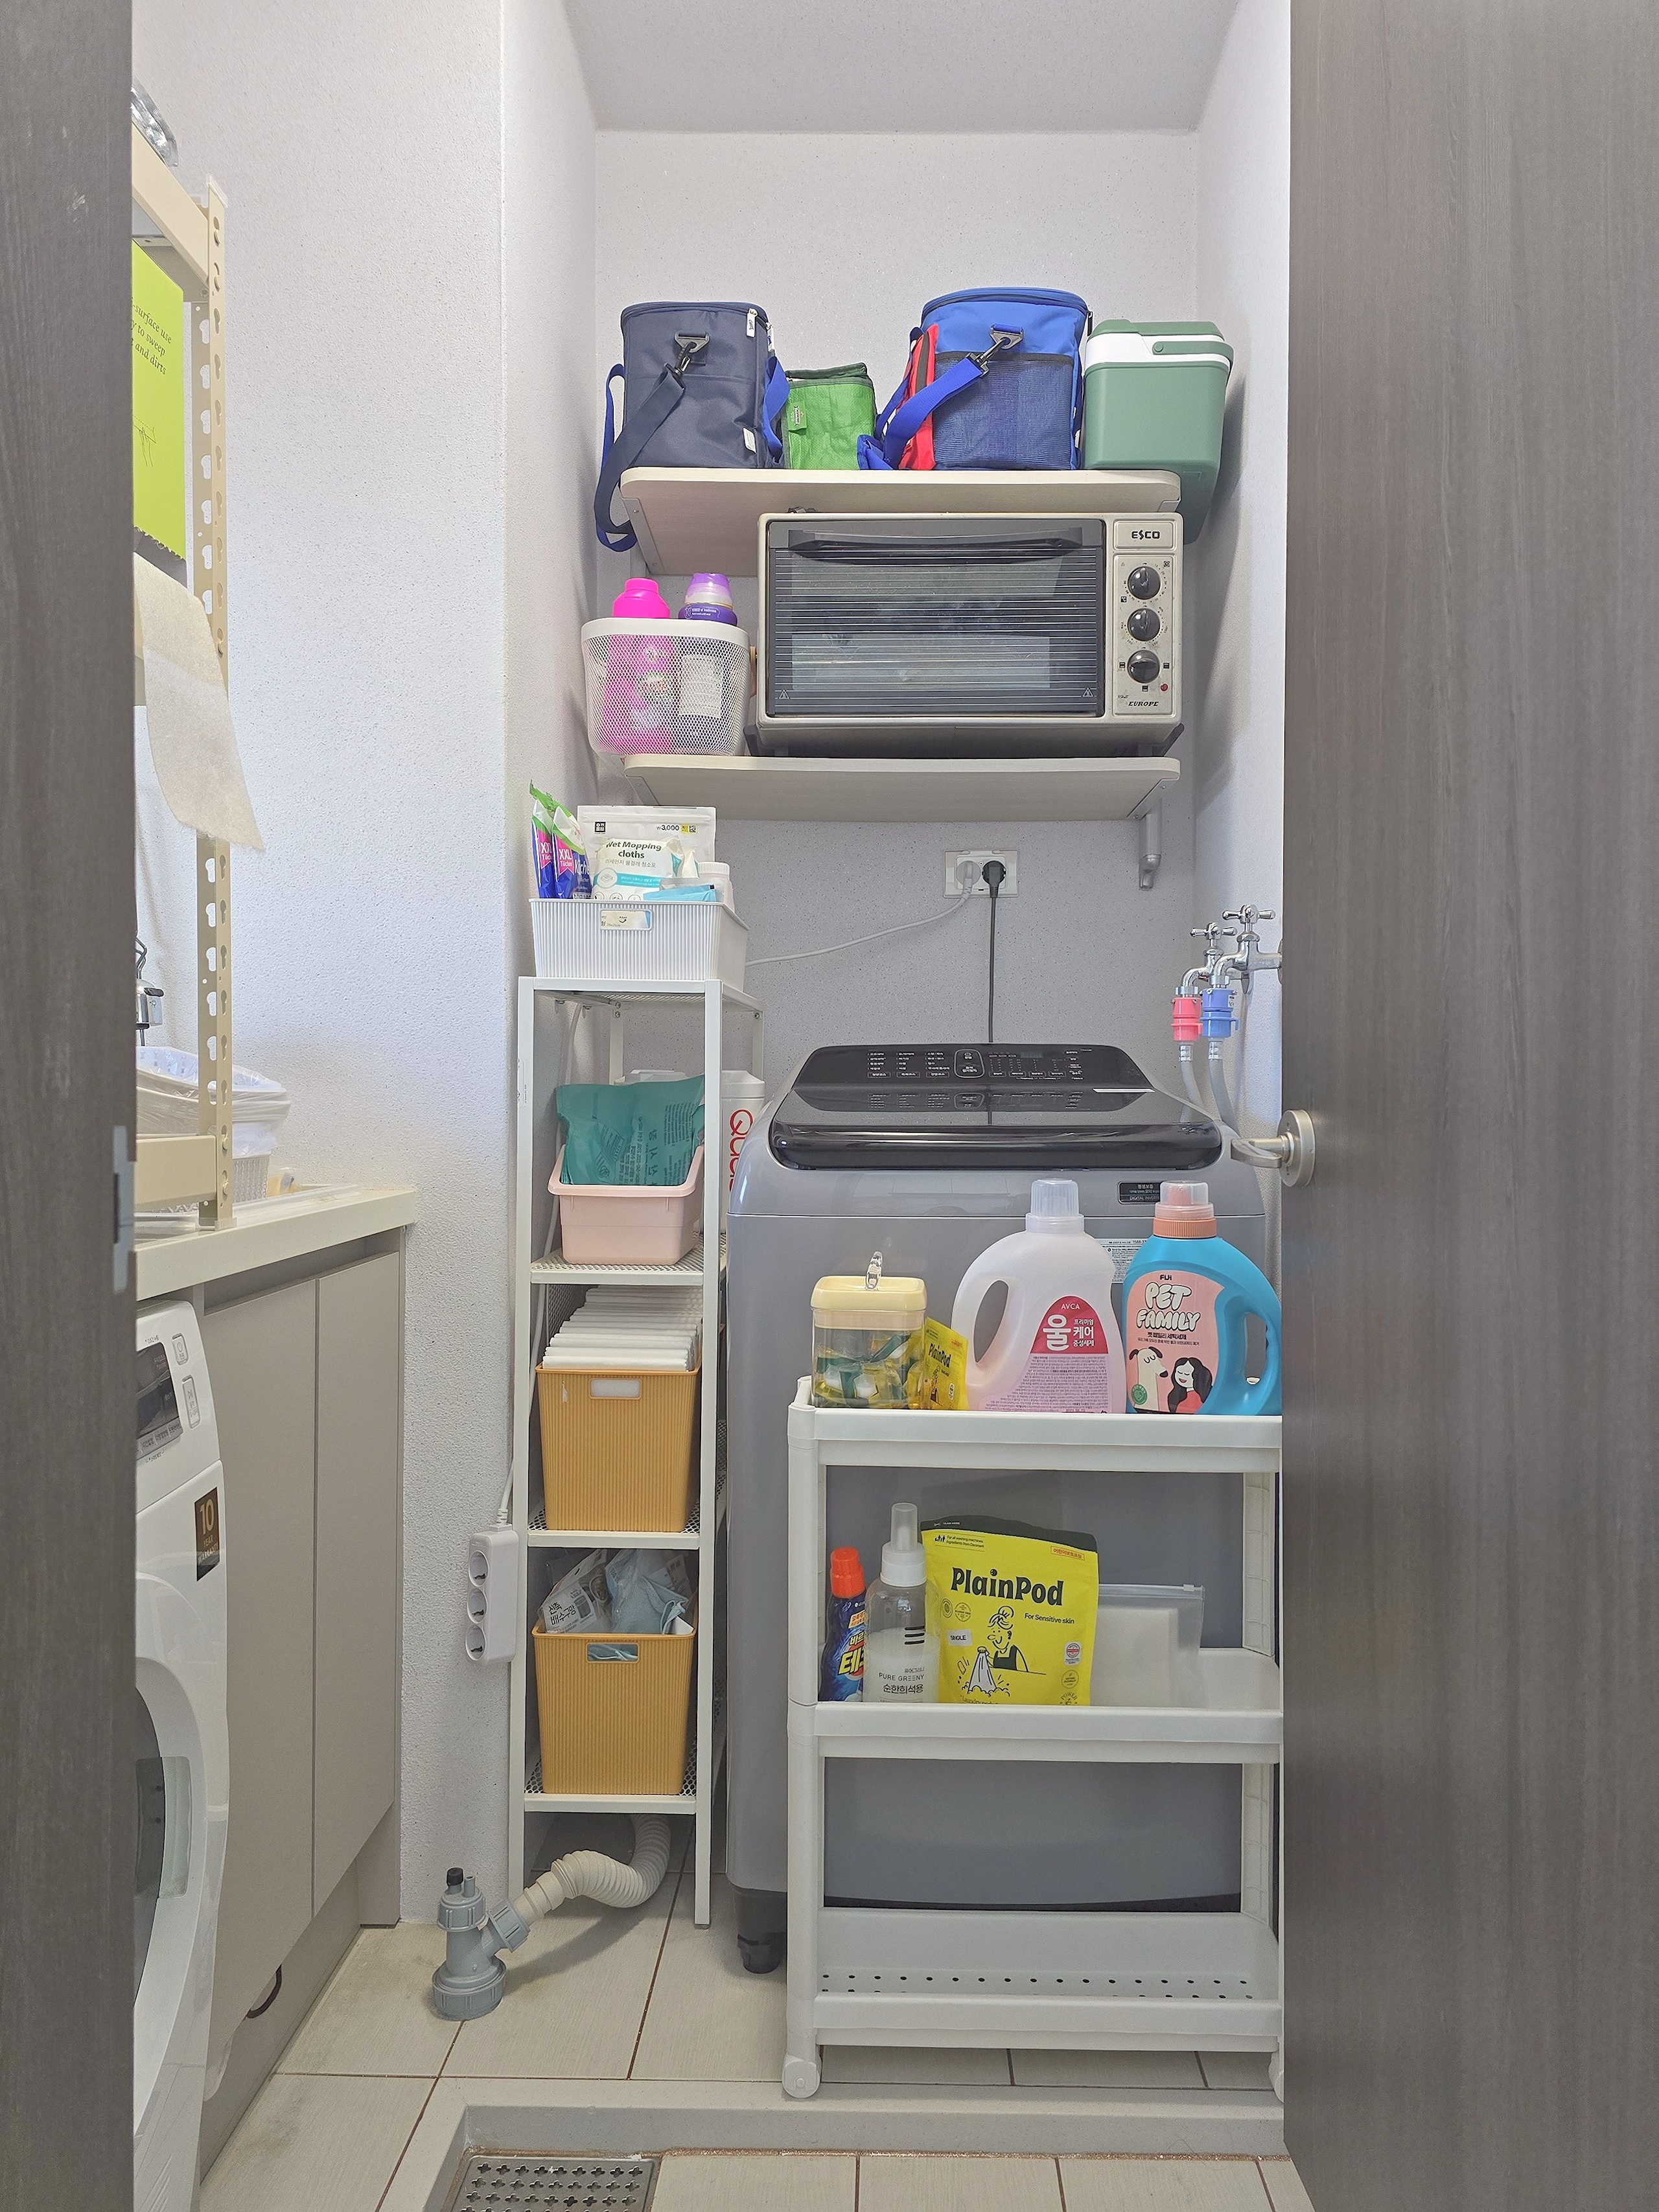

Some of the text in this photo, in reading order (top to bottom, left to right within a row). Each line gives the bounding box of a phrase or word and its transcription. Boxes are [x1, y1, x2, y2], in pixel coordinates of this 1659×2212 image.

[138, 325, 165, 357] to sweep
[161, 329, 172, 344] use
[135, 343, 167, 375] and dirts
[1131, 530, 1161, 541] ESCO
[622, 841, 662, 852] Mopping
[558, 848, 572, 860] XXL
[618, 850, 645, 859] cloths
[1144, 1282, 1192, 1311] PET
[1137, 1309, 1201, 1332] FAMILY
[1042, 1314, 1072, 1351] 울
[1073, 1326, 1094, 1339] 케어
[928, 1343, 952, 1368] PlainPod
[200, 1498, 215, 1535] 10
[203, 1534, 213, 1548] YEAR
[950, 1566, 1065, 1606] PlainPod
[549, 1601, 563, 1615] 신축
[550, 1604, 576, 1625] 배수구망
[1035, 1614, 1062, 1624] Sensitive
[879, 1672, 896, 1681] PURE
[883, 1683, 923, 1694] 순한희석용
[1060, 1692, 1078, 1701] POWER
